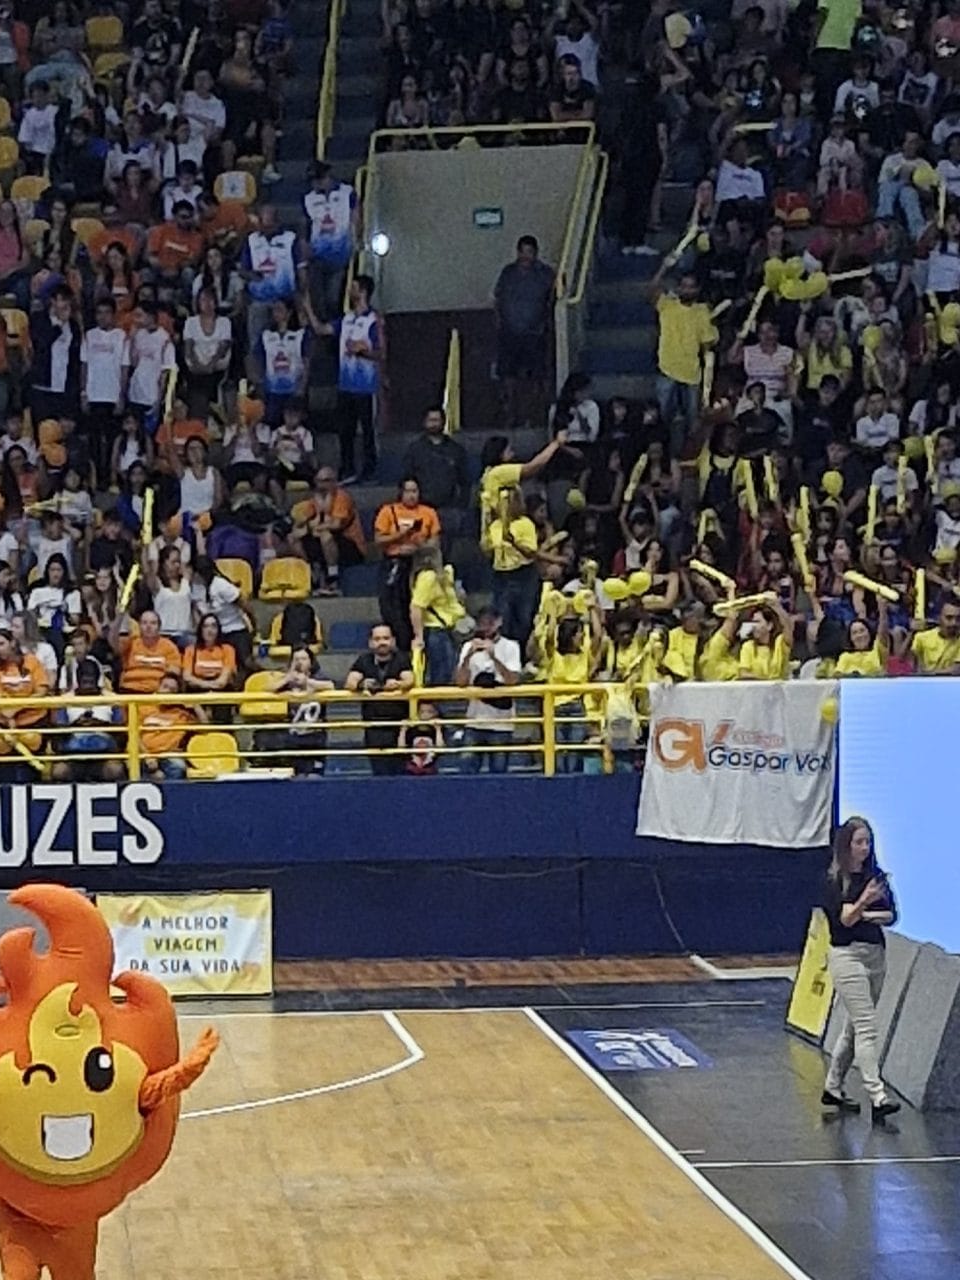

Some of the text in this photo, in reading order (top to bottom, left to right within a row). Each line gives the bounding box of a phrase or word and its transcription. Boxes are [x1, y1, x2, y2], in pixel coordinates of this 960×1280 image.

[709, 746, 788, 773] Gaspar
[142, 916, 228, 930] A MELHOR
[153, 937, 217, 951] VIAGEM
[130, 958, 241, 973] DA SUA VIDA
